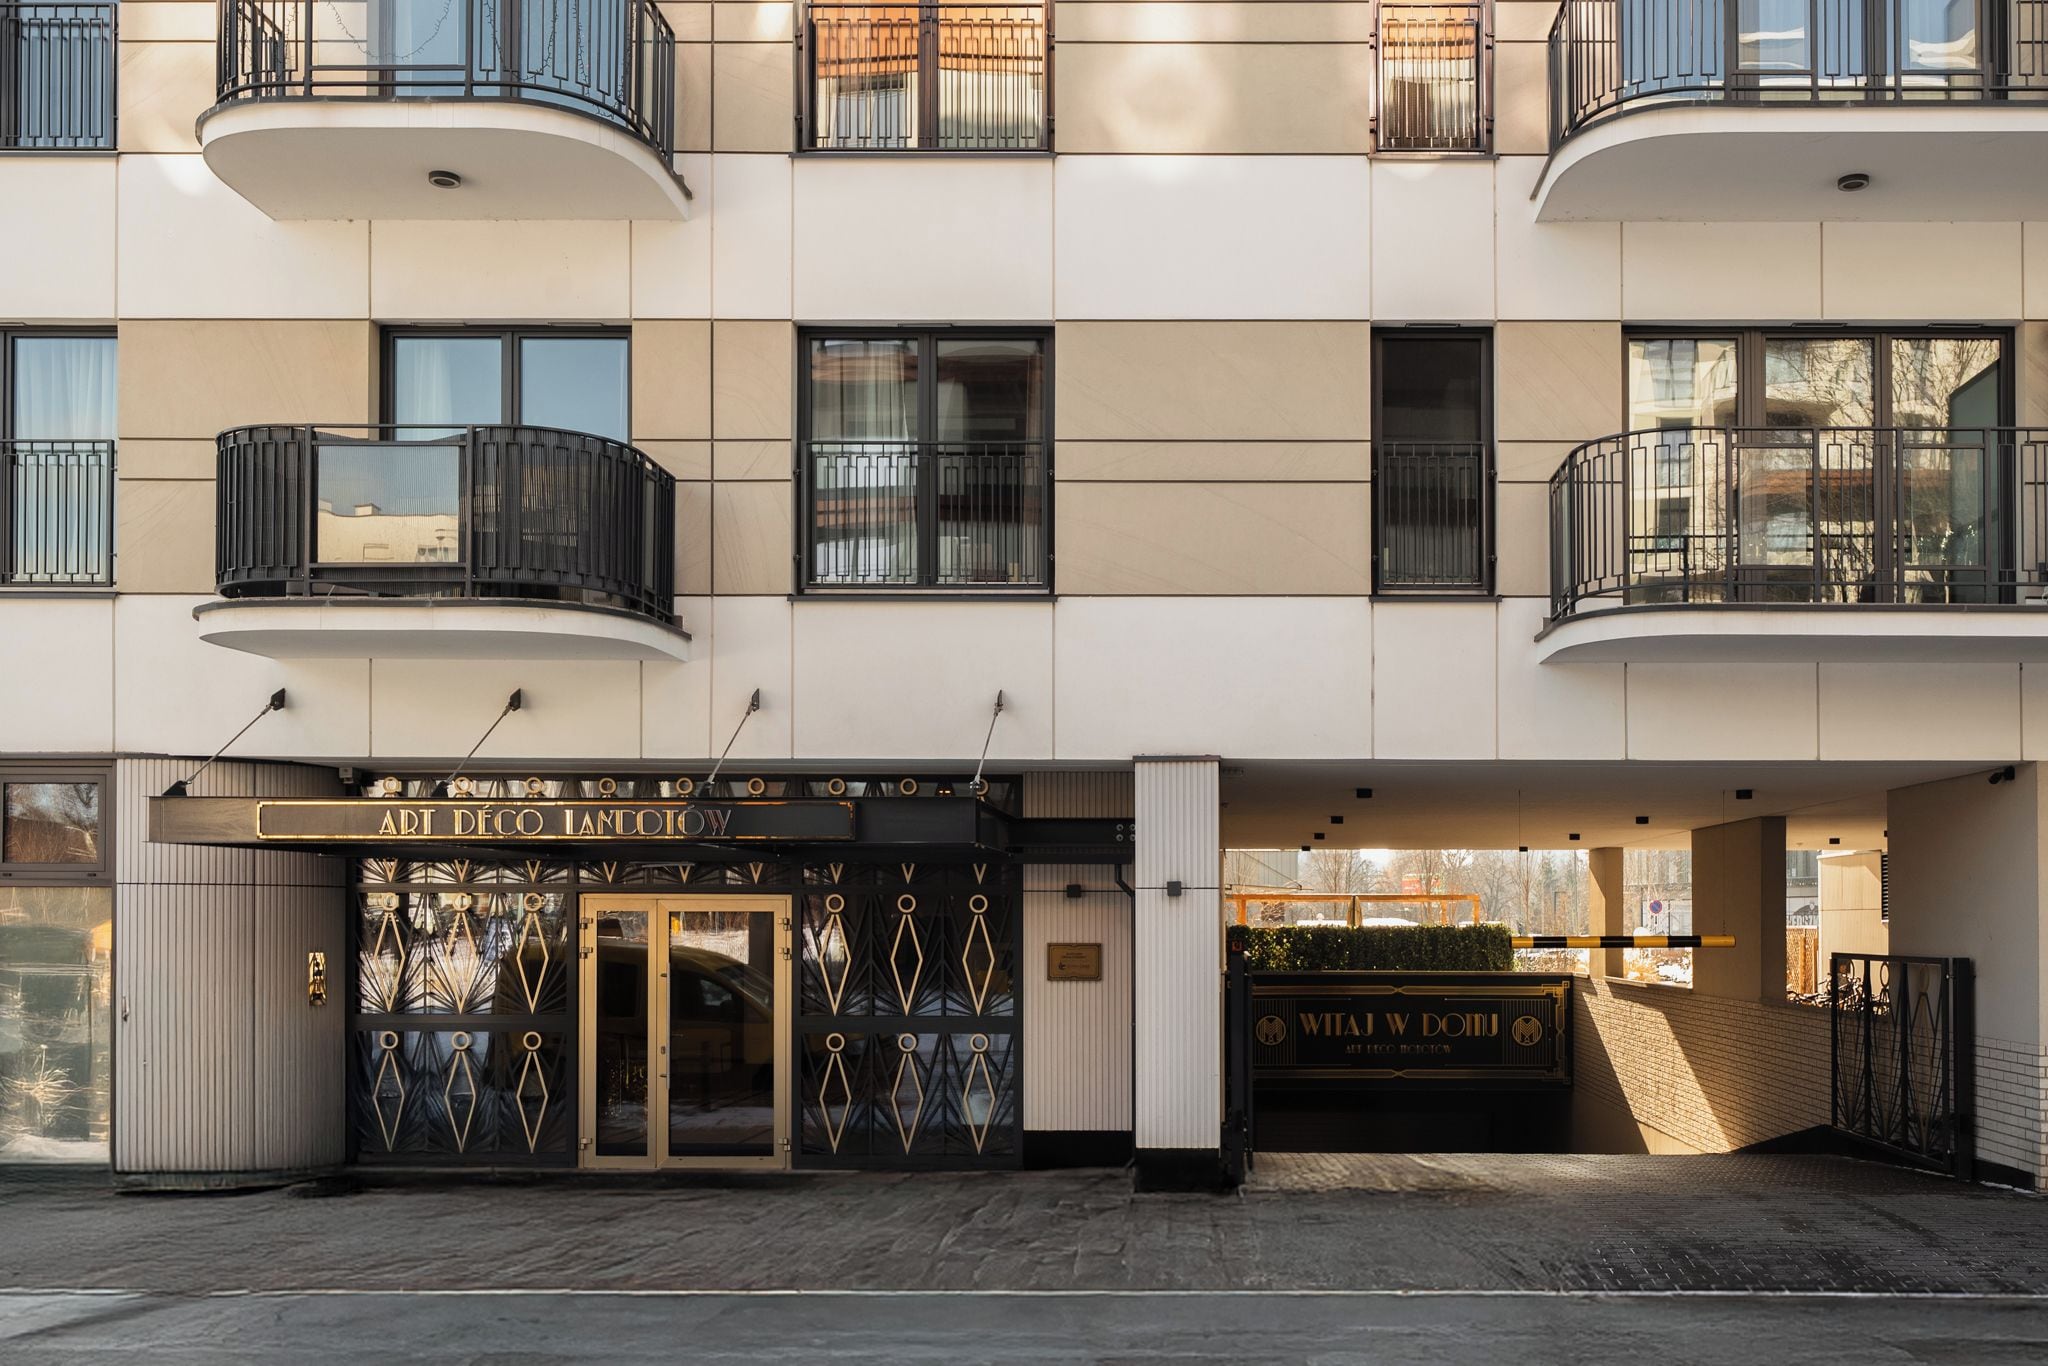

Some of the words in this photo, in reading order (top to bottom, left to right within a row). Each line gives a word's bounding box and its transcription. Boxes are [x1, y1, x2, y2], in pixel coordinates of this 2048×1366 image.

[378, 808, 436, 836] ART
[453, 804, 544, 836] DÉCO
[1299, 1011, 1374, 1037] WITAJ
[1385, 1011, 1411, 1036] W
